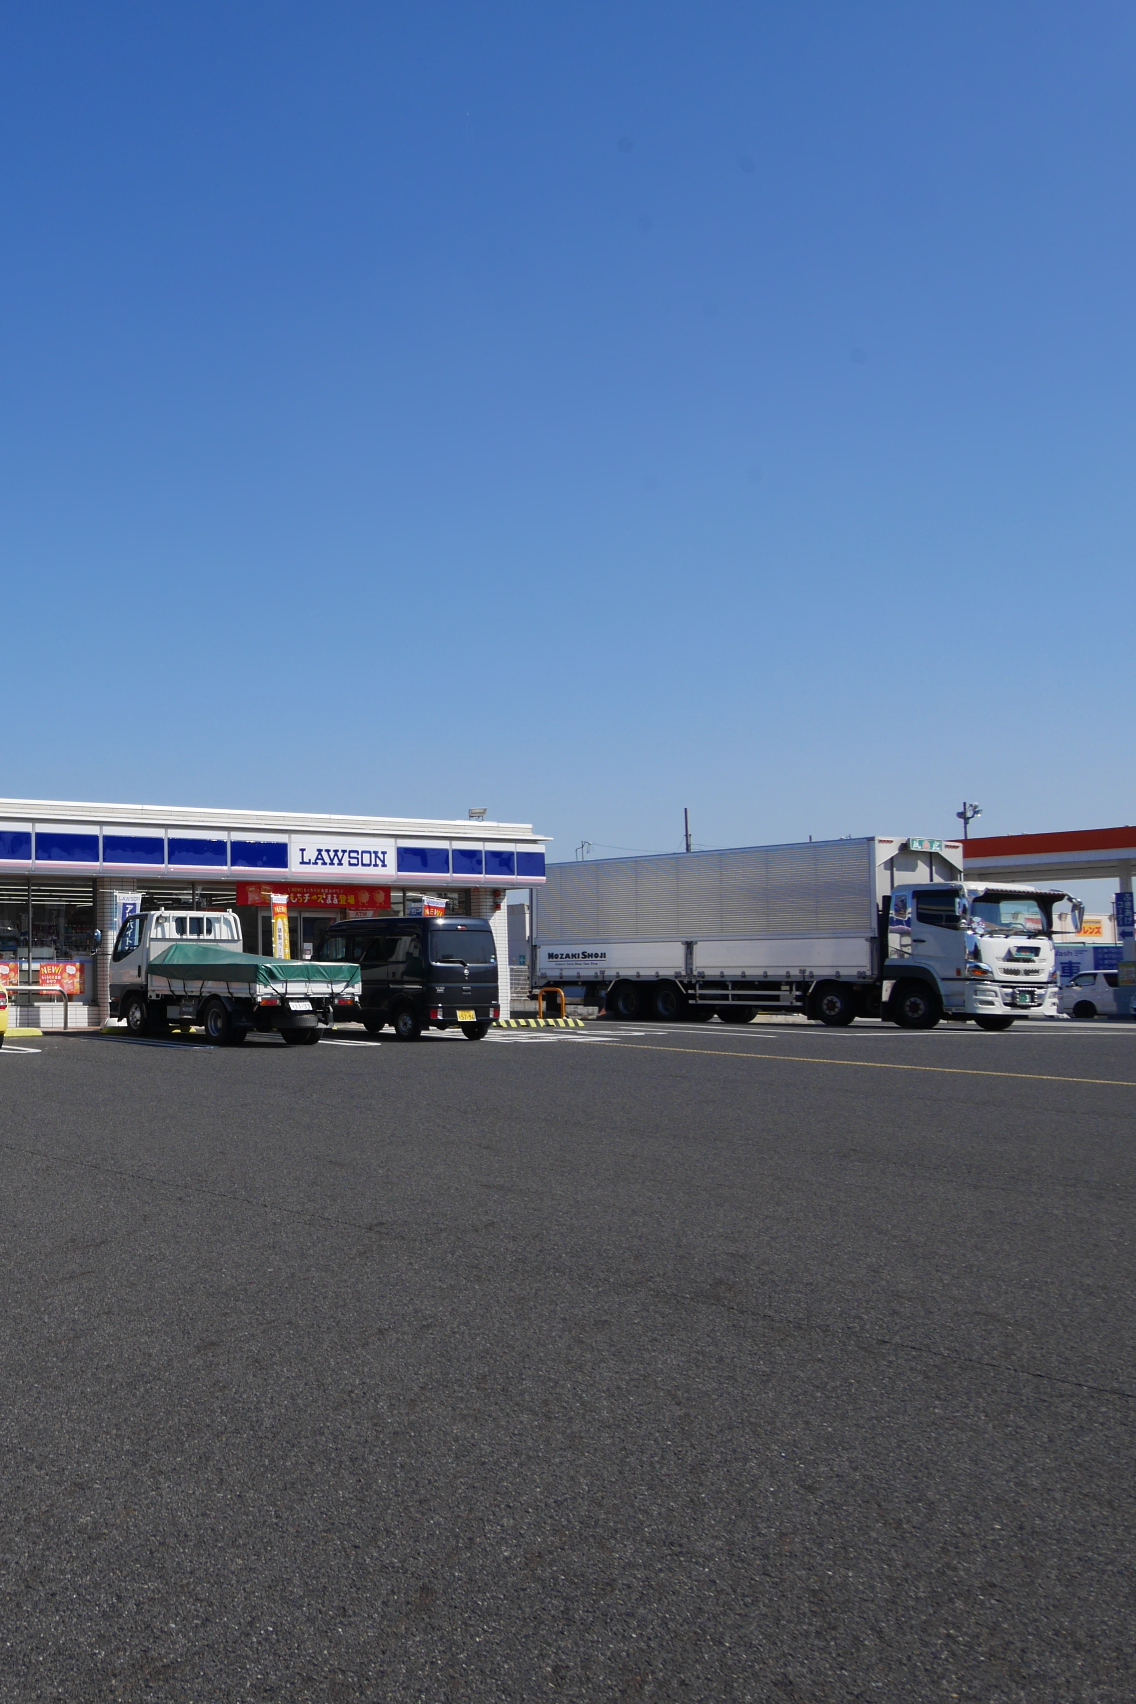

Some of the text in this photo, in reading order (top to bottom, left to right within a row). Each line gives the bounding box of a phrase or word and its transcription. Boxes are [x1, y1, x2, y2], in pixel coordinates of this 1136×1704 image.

[299, 848, 388, 867] LAWSON
[1077, 926, 1102, 935] レンズ
[581, 951, 606, 959] SHOJI
[41, 965, 62, 974] NEW!
